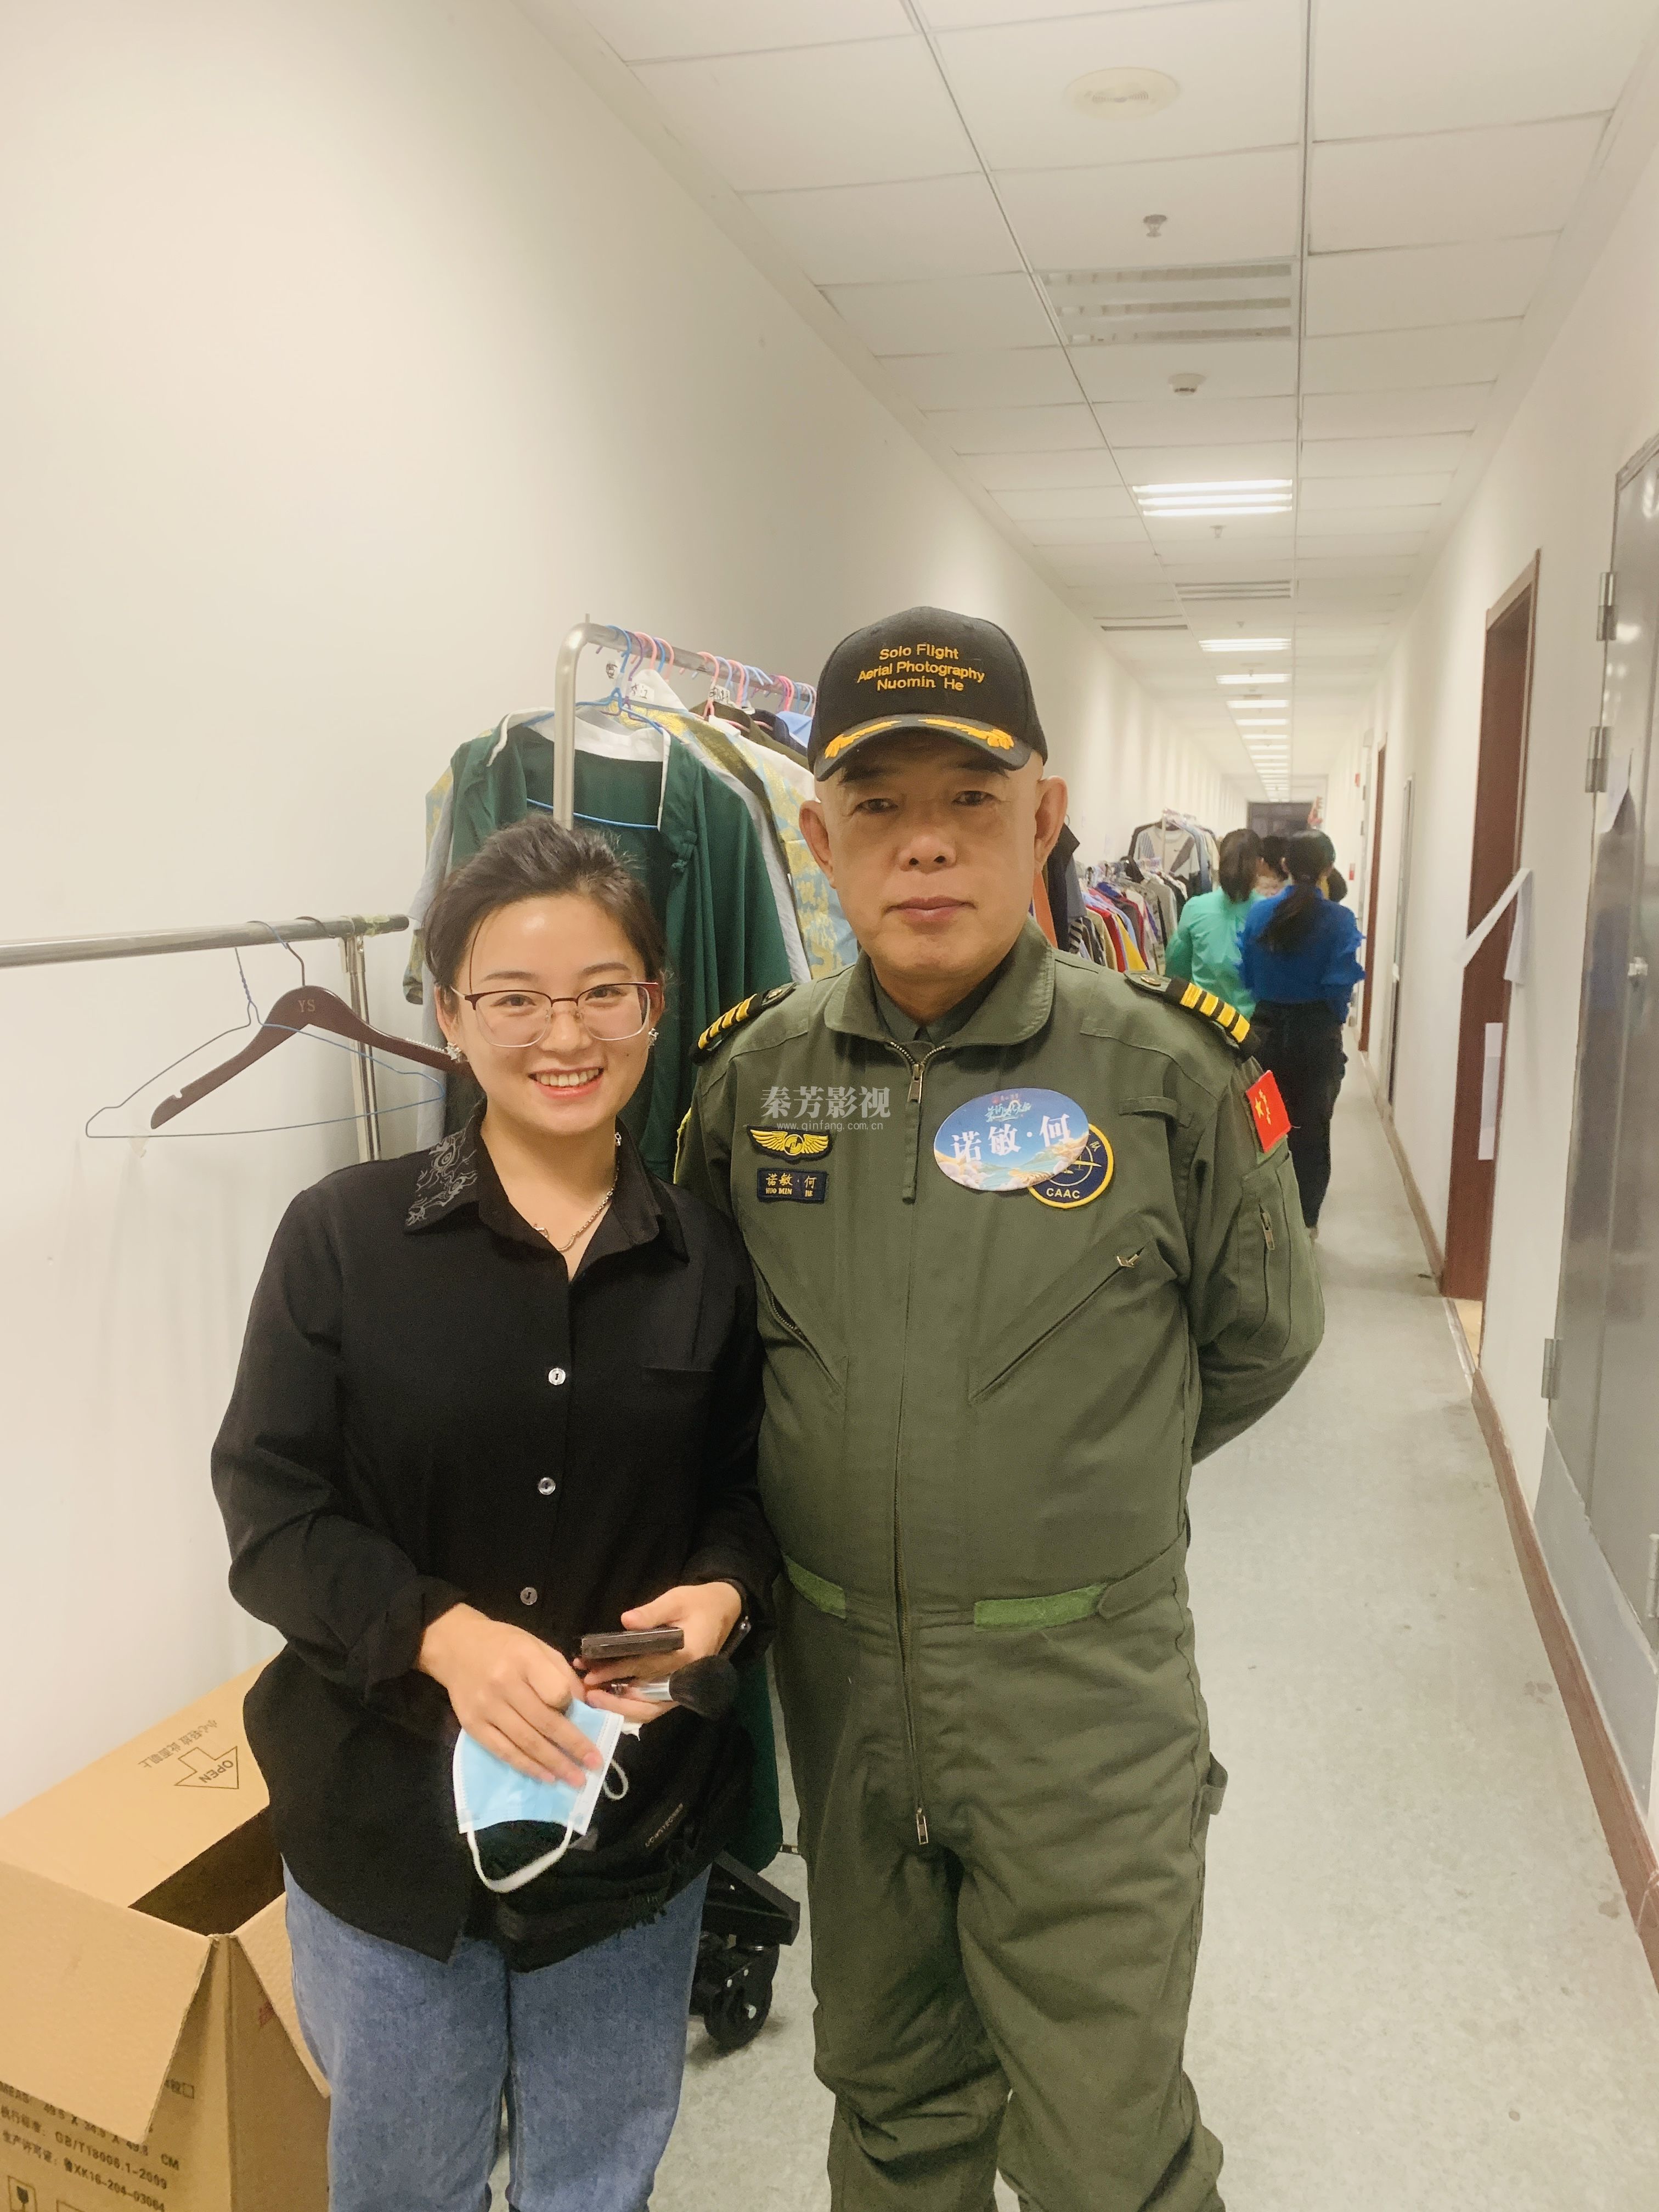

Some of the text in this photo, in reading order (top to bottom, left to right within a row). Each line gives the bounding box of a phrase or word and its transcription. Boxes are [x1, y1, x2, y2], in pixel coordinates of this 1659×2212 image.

[879, 644, 959, 661] Solo Flight
[857, 661, 985, 684] Aerial Photography
[877, 676, 964, 691] Nuomin He
[297, 999, 315, 1013] YS
[1046, 1188, 1080, 1199] CAAC
[199, 1759, 234, 1783] OPEN
[161, 2153, 179, 2171] CM
